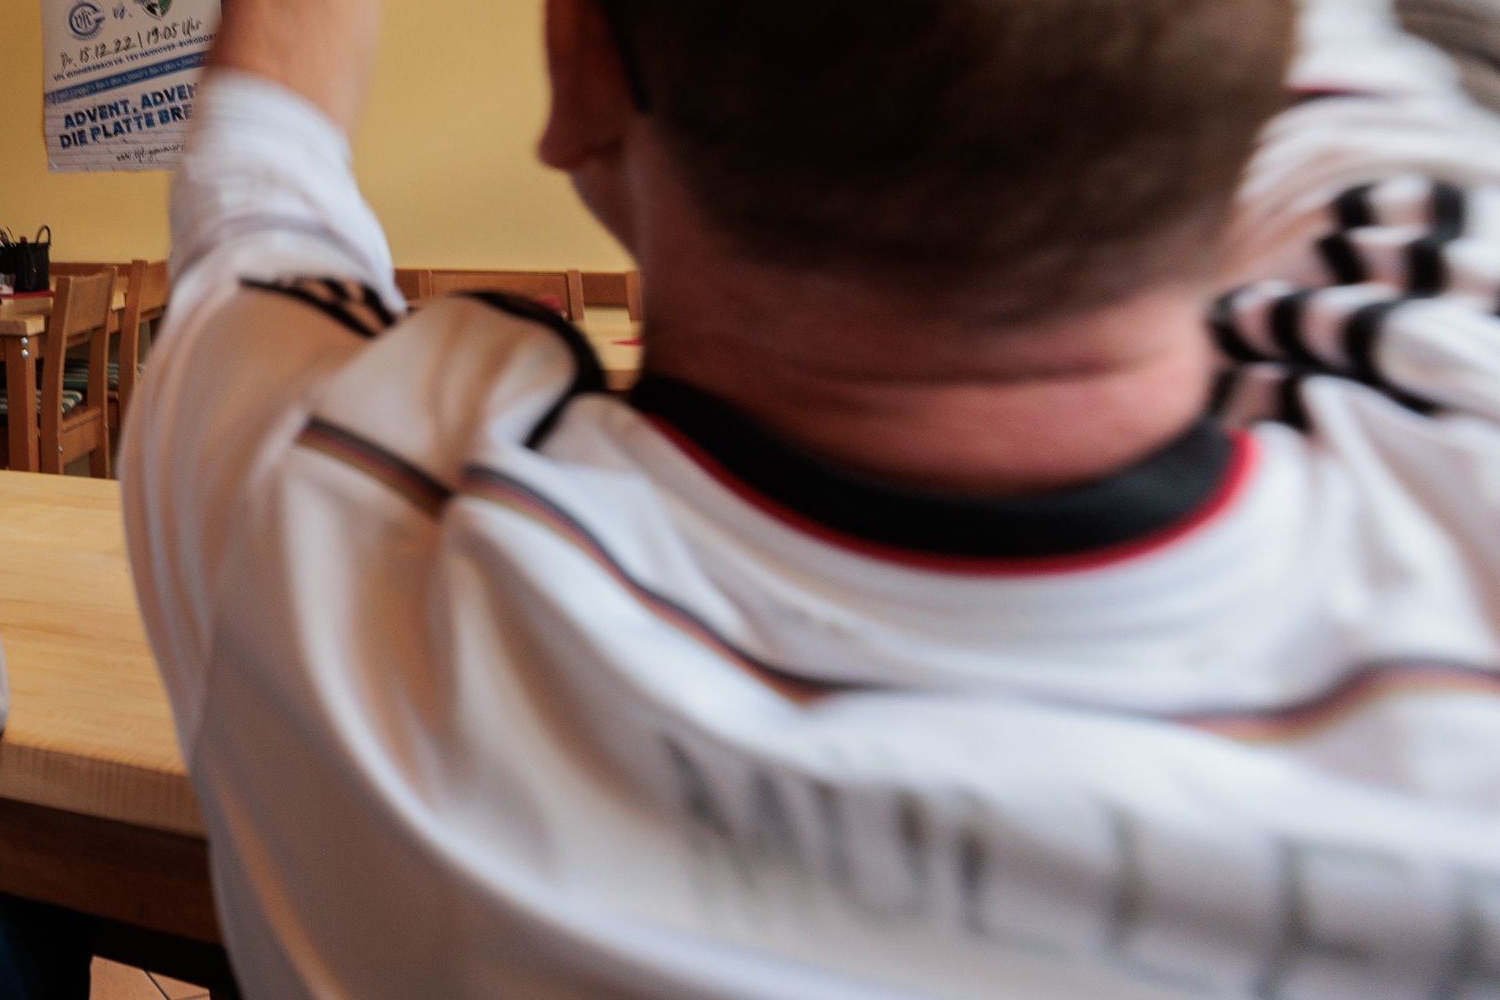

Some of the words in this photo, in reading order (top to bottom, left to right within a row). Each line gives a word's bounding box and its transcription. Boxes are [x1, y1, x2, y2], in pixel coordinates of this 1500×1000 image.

[59, 129, 89, 149] DIE
[89, 112, 156, 143] PLATTE
[157, 104, 193, 126] BRE
[64, 99, 139, 130] ADVENT,
[141, 81, 198, 109] ADVEN
